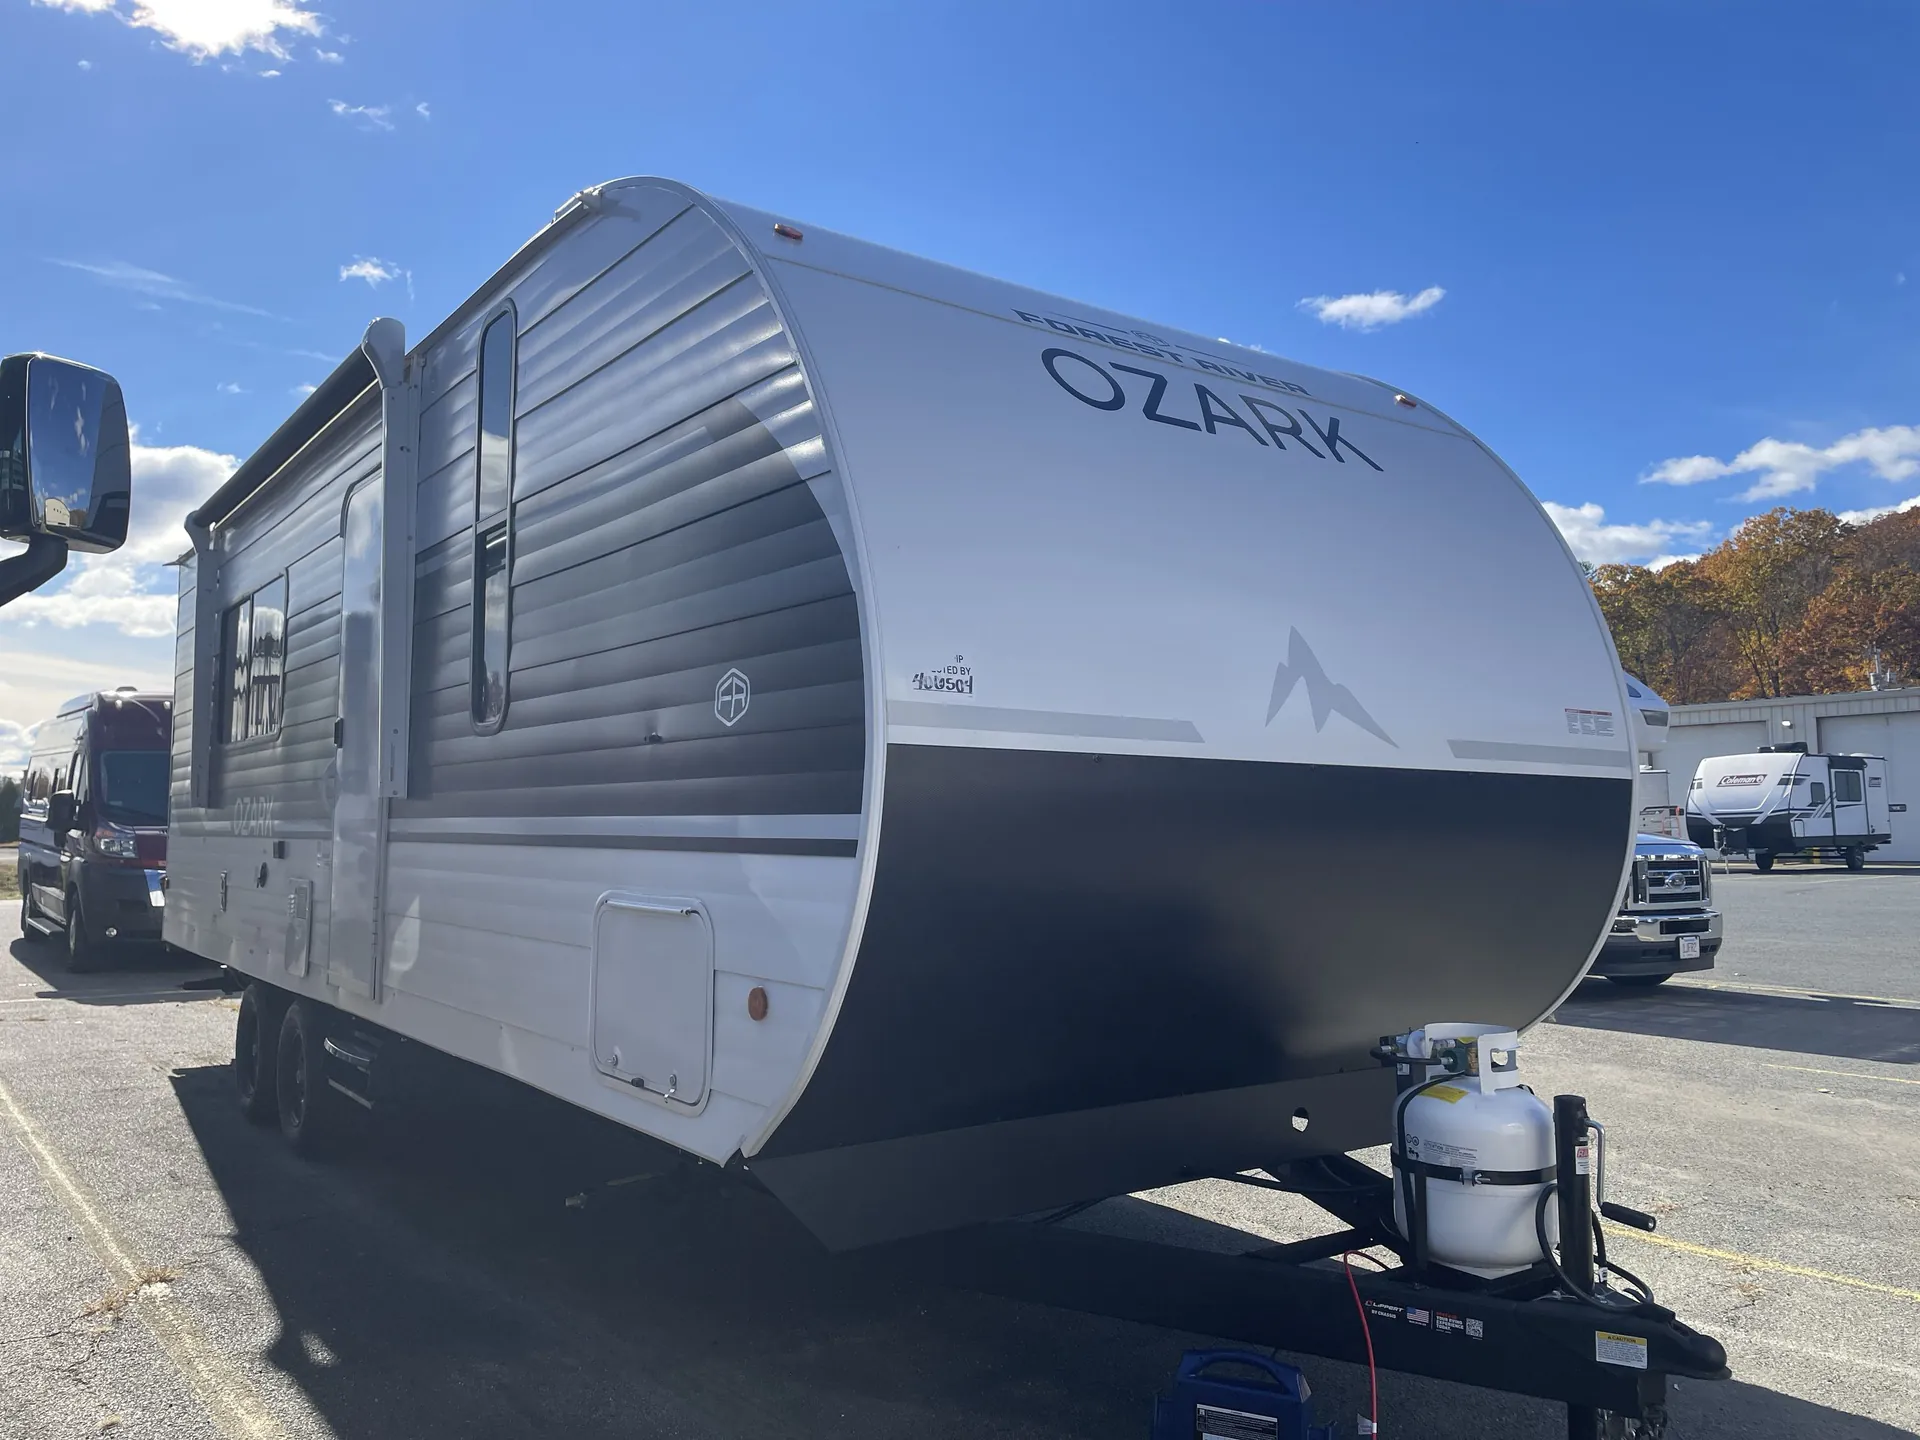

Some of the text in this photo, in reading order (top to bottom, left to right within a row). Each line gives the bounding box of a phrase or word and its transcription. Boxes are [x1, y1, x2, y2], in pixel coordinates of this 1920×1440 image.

[1010, 308, 1312, 397] FOREST RIVER
[1041, 347, 1385, 473] OZARK
[960, 666, 971, 676] BY
[1721, 775, 1757, 785] Coleman
[233, 795, 274, 838] OZARK
[1373, 1302, 1404, 1312] LIPPERT
